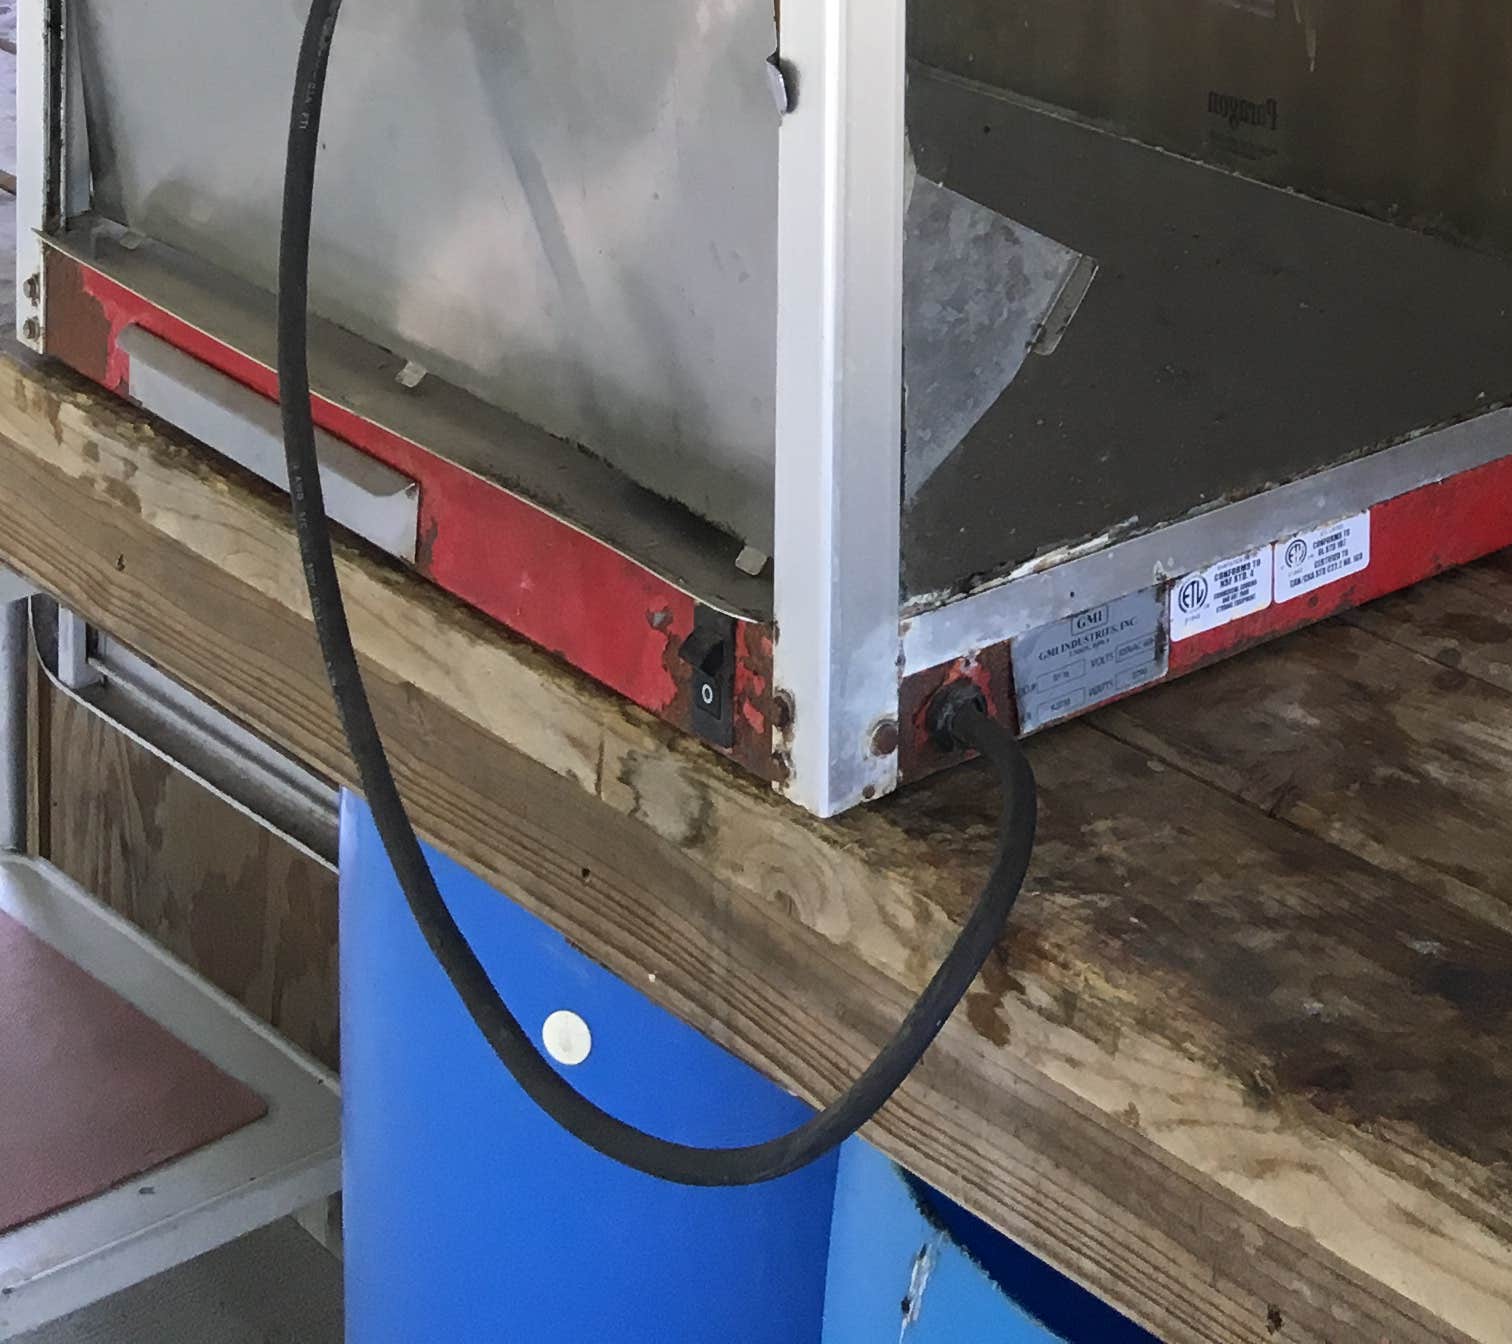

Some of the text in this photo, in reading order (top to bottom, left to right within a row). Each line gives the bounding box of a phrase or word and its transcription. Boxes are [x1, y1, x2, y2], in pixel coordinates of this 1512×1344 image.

[1213, 562, 1251, 583] CONFORMS
[1251, 557, 1261, 568] TO
[1076, 609, 1103, 630] GMI
[1038, 646, 1059, 662] GMI
